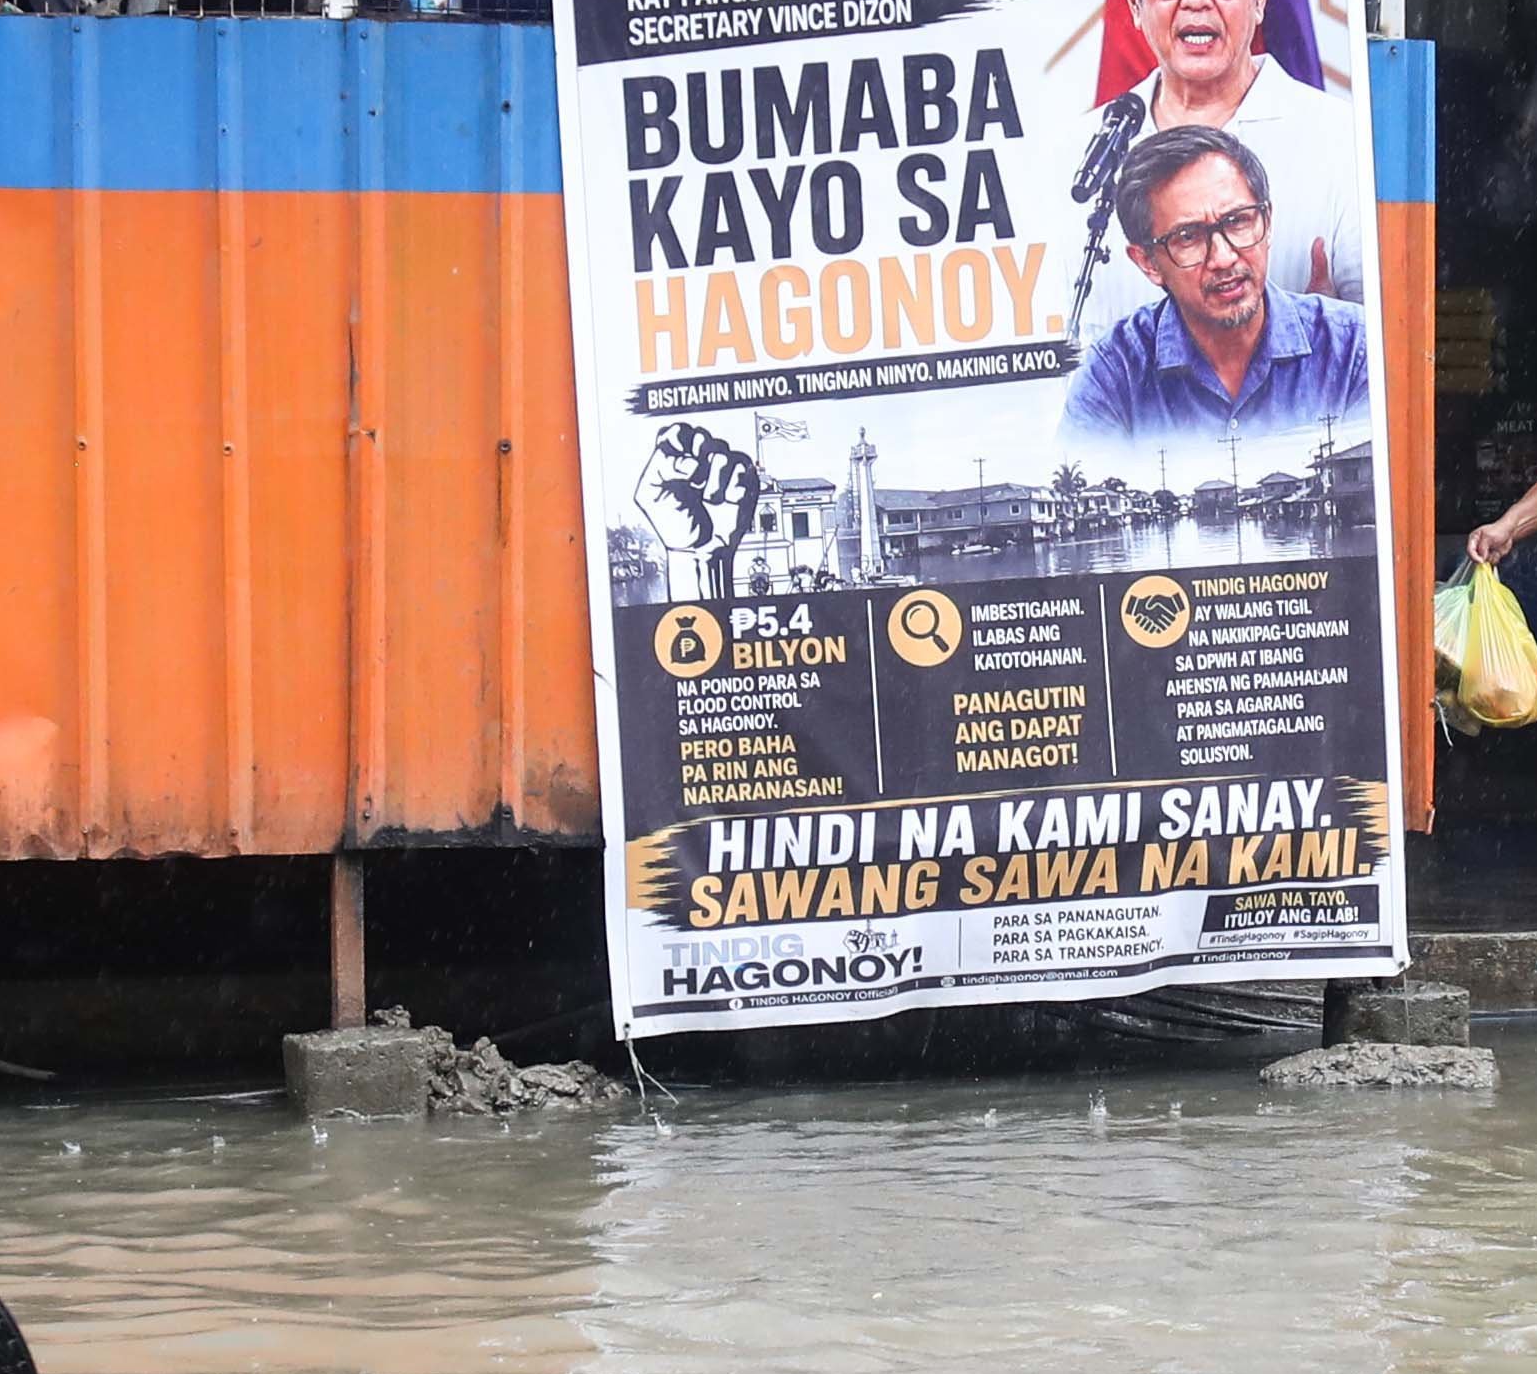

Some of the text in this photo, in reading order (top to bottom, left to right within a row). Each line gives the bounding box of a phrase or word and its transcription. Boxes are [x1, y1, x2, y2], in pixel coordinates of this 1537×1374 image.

[628, 8, 764, 46] SECRETARY
[767, 3, 837, 34] VINCE
[623, 48, 1024, 171] BUMABA
[629, 148, 1016, 273] KAYO SA
[635, 243, 1063, 374] HAGONOY.
[647, 350, 1061, 411] BISITAHIN NINYO. TINGNAN NINYO. MAKINIG KAYO.
[1192, 572, 1329, 598] TINDIG HAGONOY
[971, 598, 1085, 623] IMBESTIGAHAN.
[1194, 598, 1312, 623] AY WALANG TIGIL
[972, 624, 1061, 647] ILABAS ANG
[1188, 620, 1349, 647] NA NAKIKIPAG-UGNAYAN
[732, 635, 847, 670] BILYON
[974, 647, 1087, 671] KATOTOHANAN.
[1175, 647, 1304, 672] SA DPWH AT IBANG
[676, 672, 821, 697] NA PONDO PARA SA
[1166, 667, 1348, 697] AHENSYA NG PAMAHALAAN
[678, 692, 802, 716] FLOOD CONTROL
[953, 685, 1086, 715] PANAGUTIN
[1177, 693, 1304, 719] PARA SA AGARANG
[679, 713, 778, 736] SA HAGONOY.
[955, 714, 1082, 745] ANG DAPAT
[1176, 715, 1324, 742] AT PANGMATAGALANG
[680, 734, 796, 760] PERO BAHA
[956, 743, 1079, 773] MANAGOT!
[1180, 744, 1253, 765] SOLUSYON.
[682, 757, 799, 784] PA RIN ANG
[683, 777, 843, 806] NARARANASAN!
[708, 778, 1332, 873] HINDI NA KAMI SANAY.
[689, 828, 1371, 927] SAWANG SAWA NA KAMI.
[1235, 890, 1349, 912] SAWA NA TAYO.
[993, 905, 1162, 929] PARA SA PANANAGUTAN.
[1224, 906, 1359, 929] ITULOY ANG ALAB!
[993, 926, 1150, 946] PARA SA PAGKAKAISA.
[1209, 929, 1369, 945] #TindigHagonoy #SagipHagonoy
[663, 933, 804, 967] TINDIG
[993, 939, 1165, 964] PARA SA TRANSPARENCY.
[663, 946, 923, 996] HAGONOY!
[749, 993, 789, 1007] TINDIG
[792, 990, 852, 1003] HAGONOY
